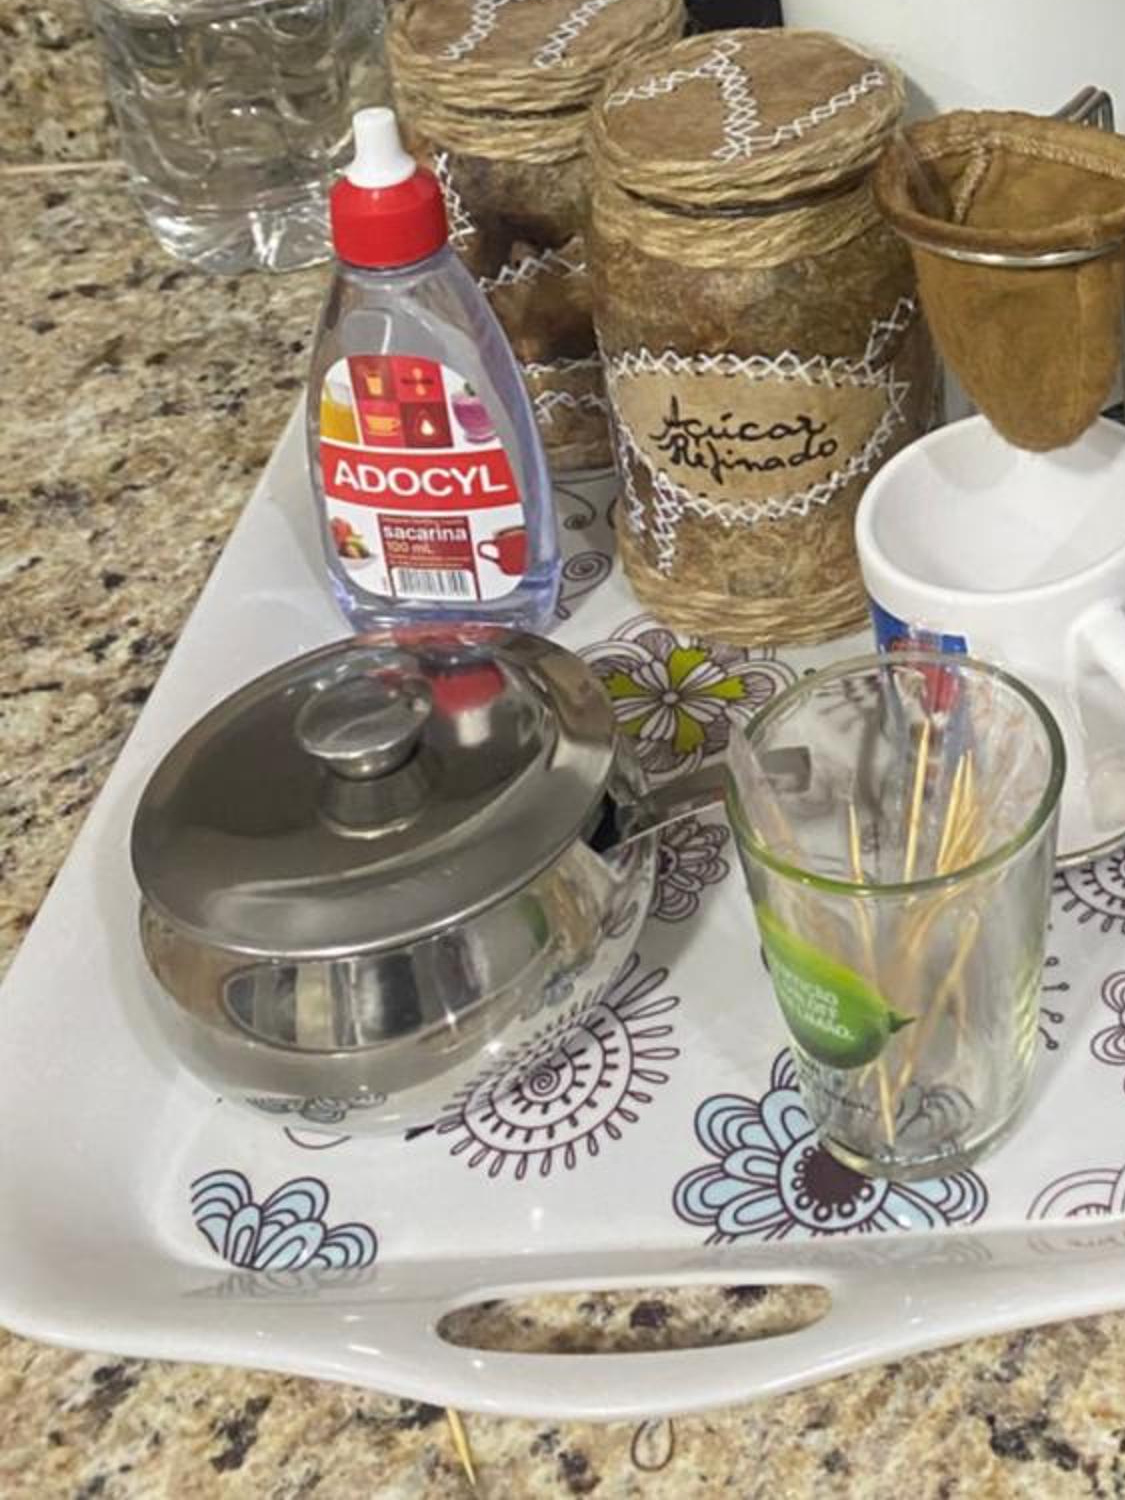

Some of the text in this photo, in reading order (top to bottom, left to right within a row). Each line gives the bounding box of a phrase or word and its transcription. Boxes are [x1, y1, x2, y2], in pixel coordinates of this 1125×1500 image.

[658, 432, 838, 485] Refinado
[333, 459, 509, 497] ADOCYL
[383, 523, 468, 542] sacarina
